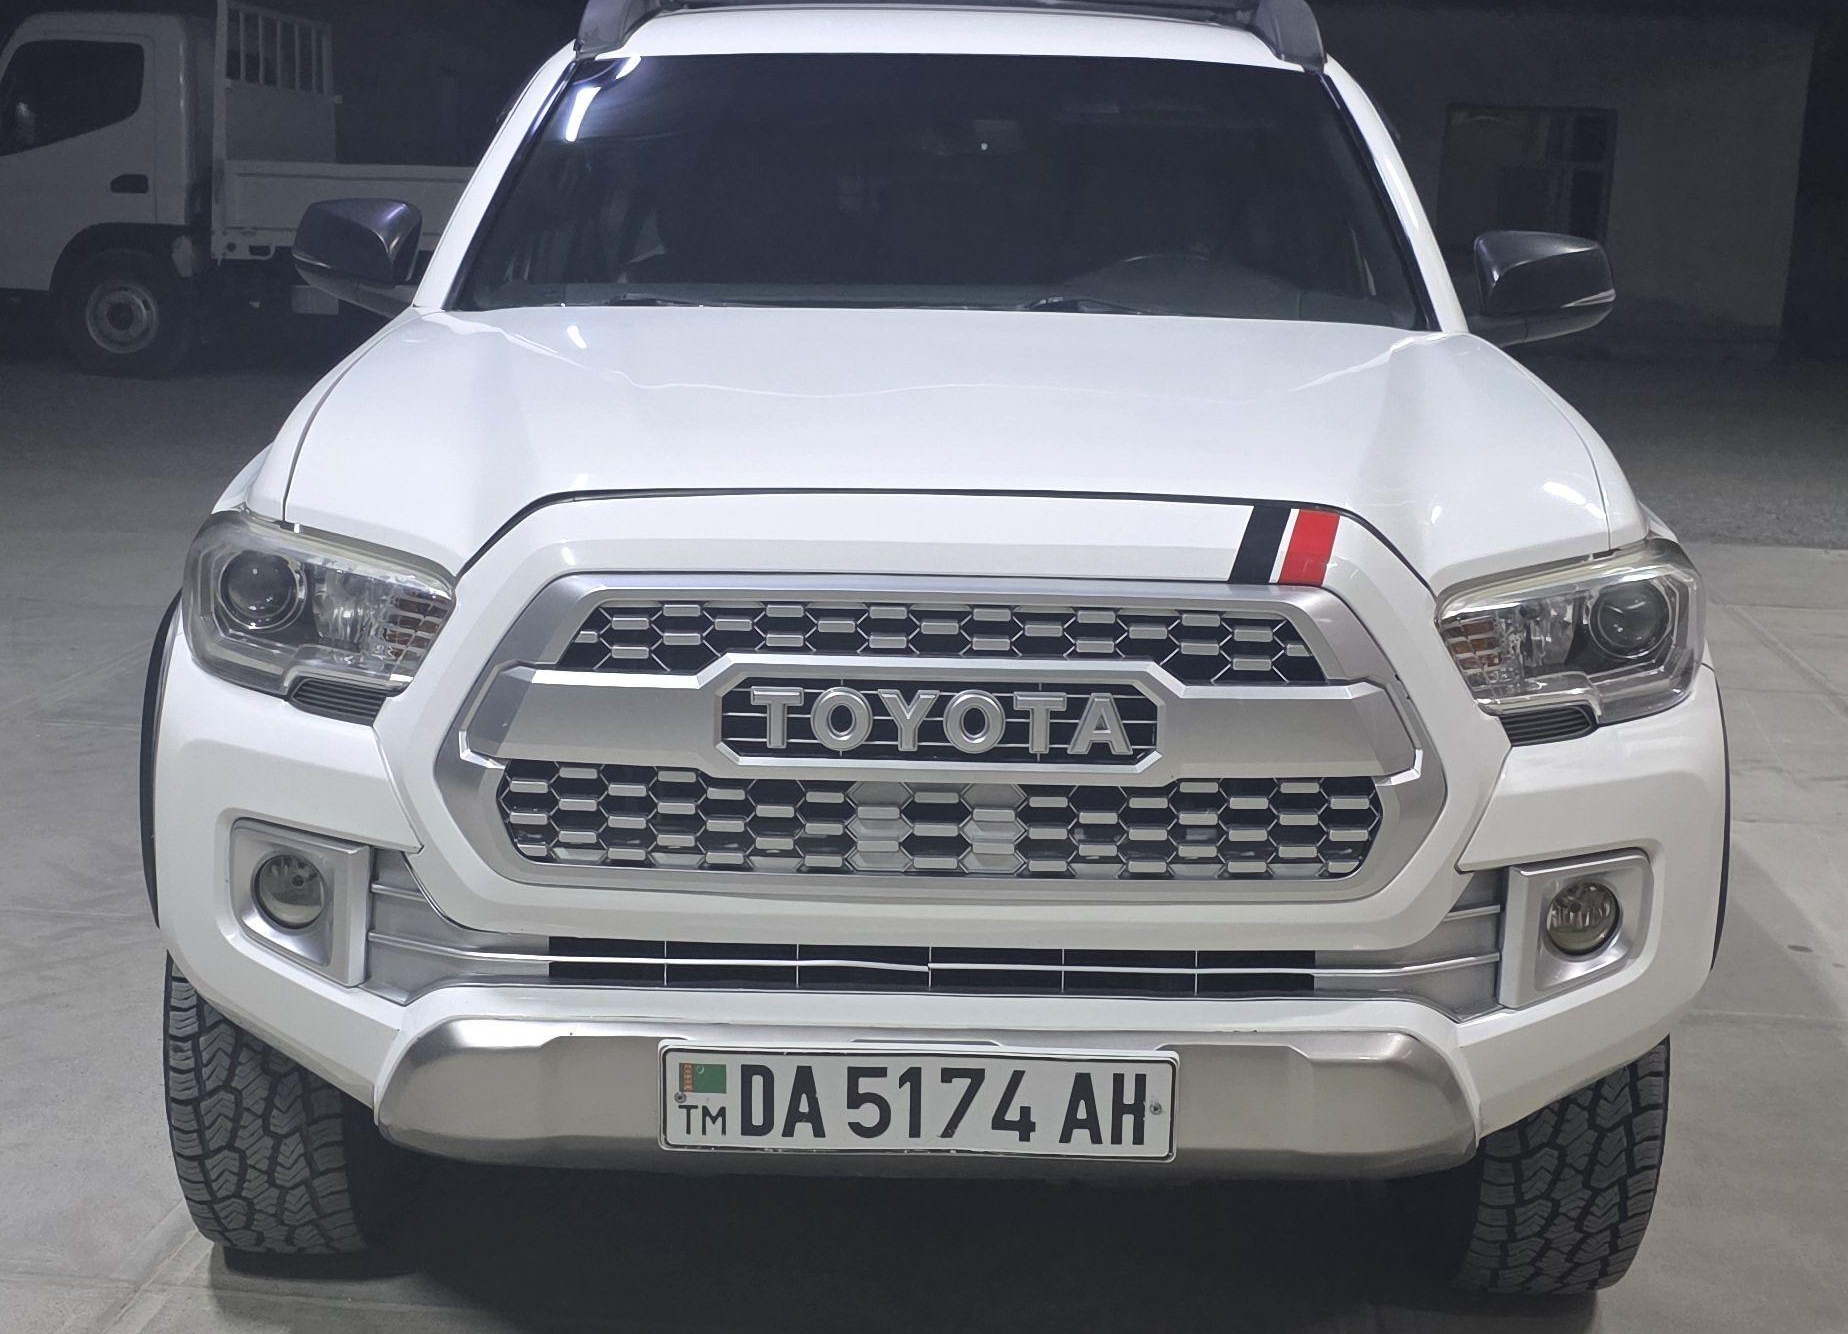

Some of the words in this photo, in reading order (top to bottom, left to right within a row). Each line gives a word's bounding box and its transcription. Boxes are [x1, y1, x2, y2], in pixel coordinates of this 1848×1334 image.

[750, 686, 1134, 756] TOYOTA
[678, 1104, 727, 1137] TM
[740, 1063, 826, 1139] DA
[846, 1066, 1036, 1143] 5174
[1058, 1072, 1147, 1146] AH
